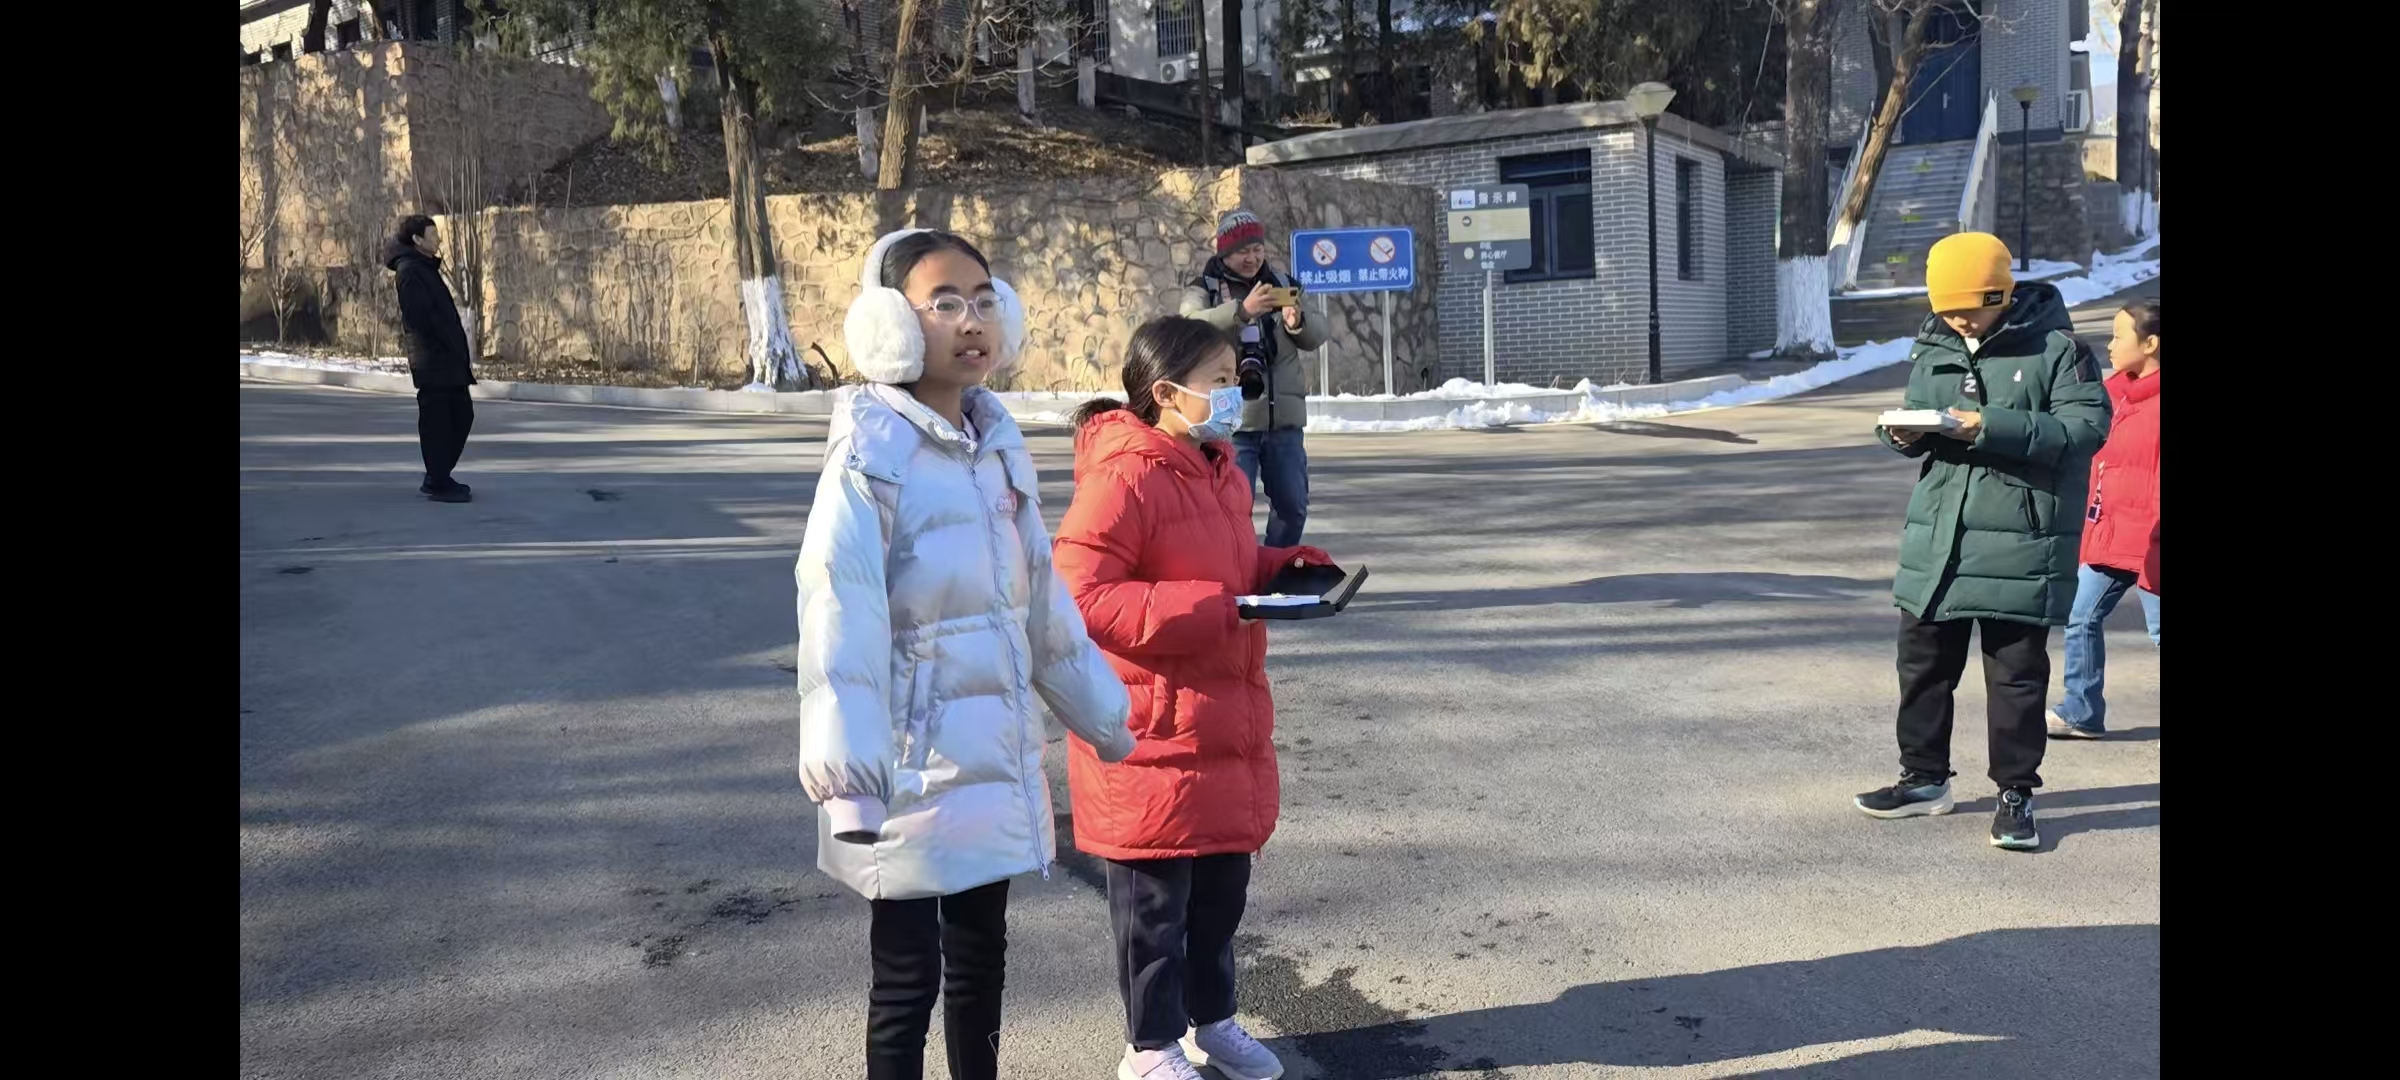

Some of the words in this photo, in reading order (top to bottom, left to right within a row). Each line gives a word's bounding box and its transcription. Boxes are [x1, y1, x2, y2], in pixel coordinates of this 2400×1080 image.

[1300, 269, 1351, 285] 禁止吸烟
[1358, 266, 1409, 282] 禁止带火种
